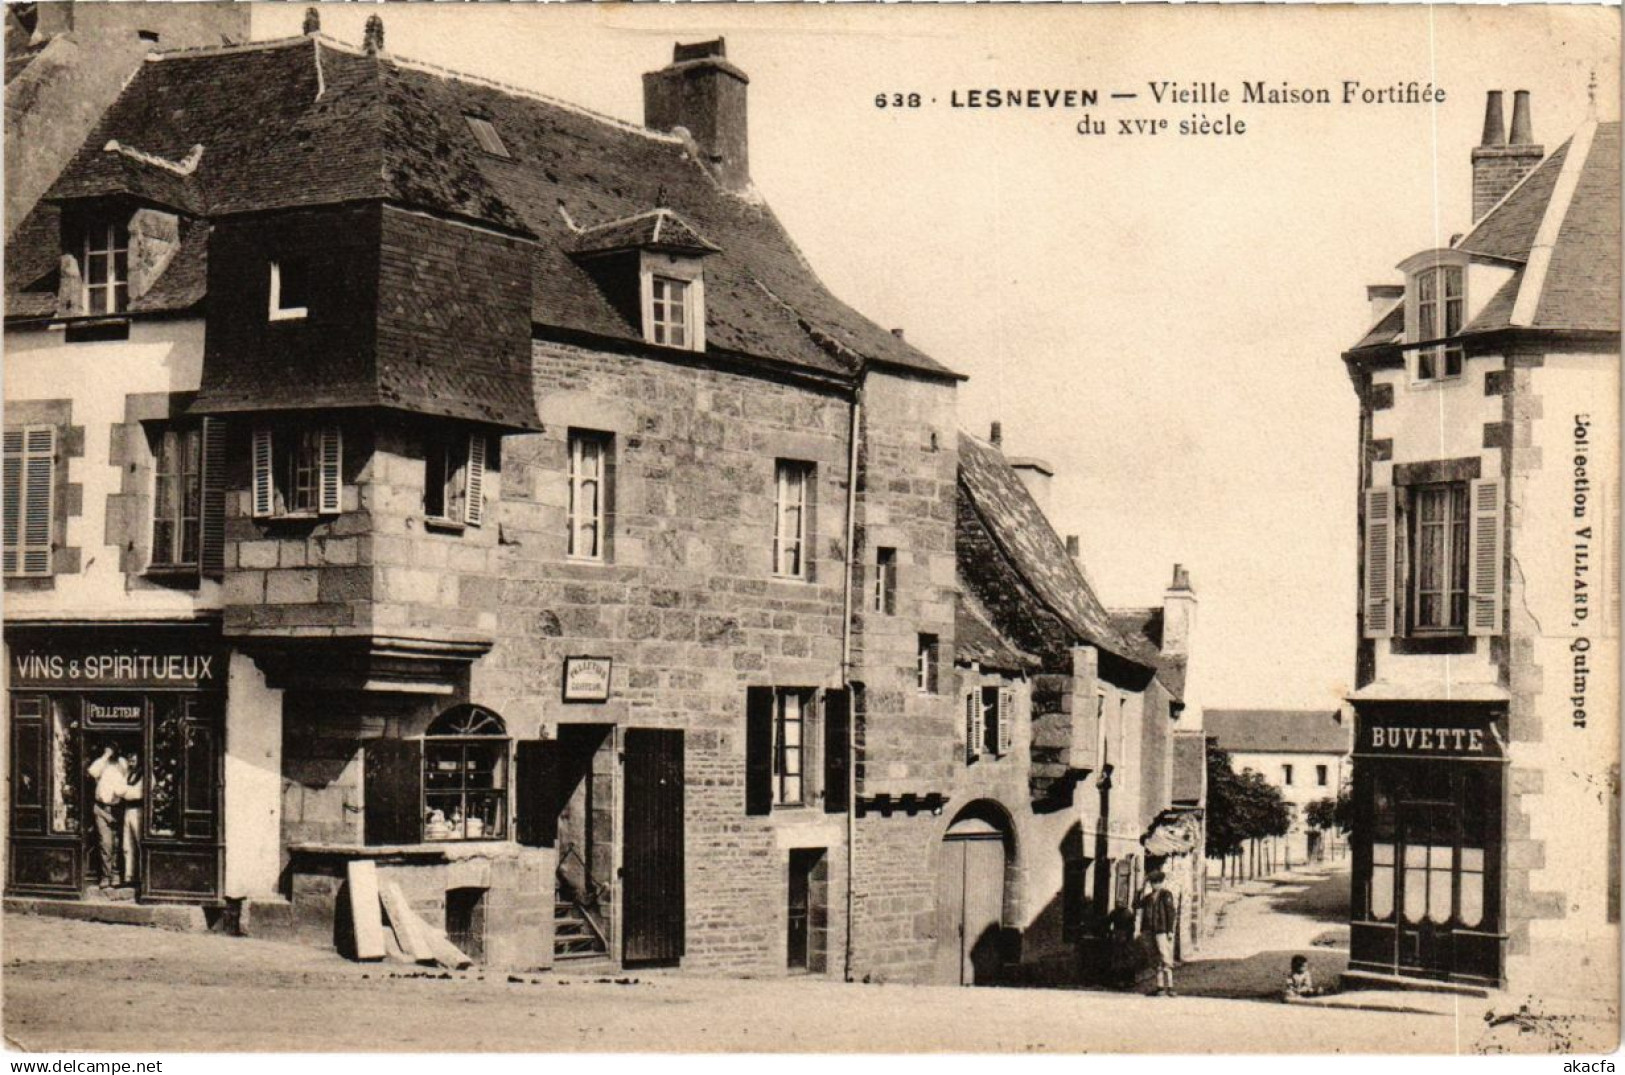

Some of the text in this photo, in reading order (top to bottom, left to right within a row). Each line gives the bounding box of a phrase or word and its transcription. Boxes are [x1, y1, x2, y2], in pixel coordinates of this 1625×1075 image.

[69, 659, 79, 678] &
[84, 651, 213, 679] SPIRITUEUX
[1371, 726, 1484, 752] BUVETTE
